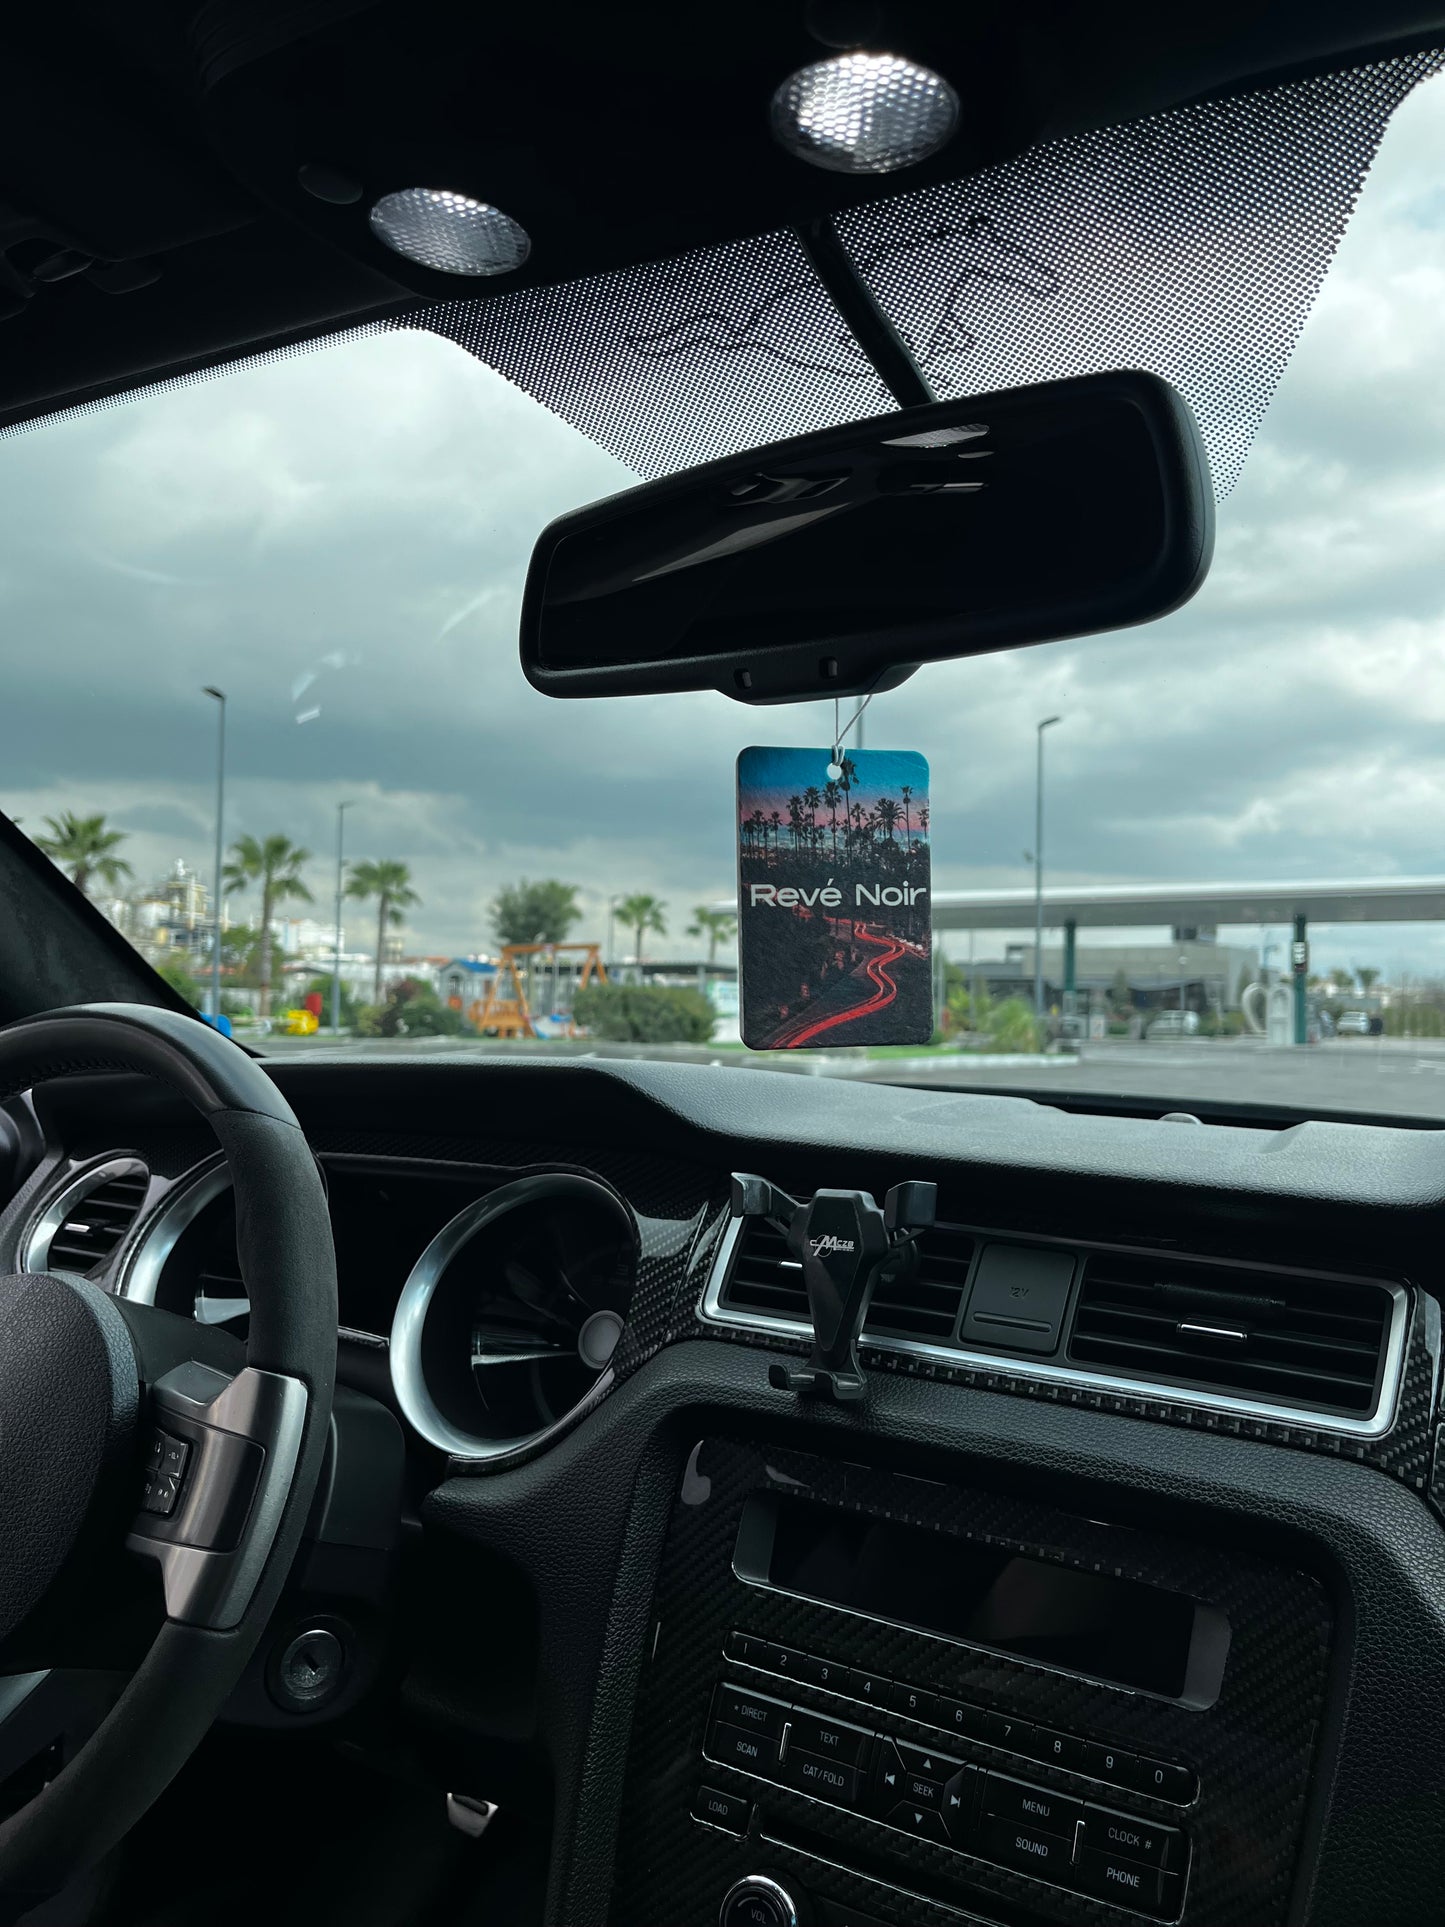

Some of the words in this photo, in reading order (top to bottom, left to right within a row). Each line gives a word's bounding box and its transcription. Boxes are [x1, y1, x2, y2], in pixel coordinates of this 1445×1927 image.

[750, 878, 842, 907] Revé
[856, 880, 927, 906] Noir
[740, 1704, 768, 1722] DIRECT
[780, 1654, 788, 1667] 2
[820, 1667, 829, 1680] 3
[863, 1681, 872, 1693] 4
[909, 1694, 917, 1707] 5
[955, 1709, 963, 1722] 6
[1004, 1725, 1012, 1737] 7
[1053, 1740, 1062, 1753] 8
[1105, 1755, 1113, 1769] 9
[1154, 1770, 1163, 1784] 0
[819, 1730, 840, 1747] TEXT
[736, 1741, 758, 1758] SCAN
[802, 1763, 845, 1787] CAT/FOLD
[912, 1781, 934, 1798] SEEK
[708, 1800, 728, 1816] LOAD
[1022, 1798, 1050, 1817] MENU
[1015, 1835, 1049, 1857] SOUND
[1107, 1826, 1141, 1847] CLOCK
[1106, 1866, 1141, 1888] PHONE
[751, 1908, 767, 1924] VOL
